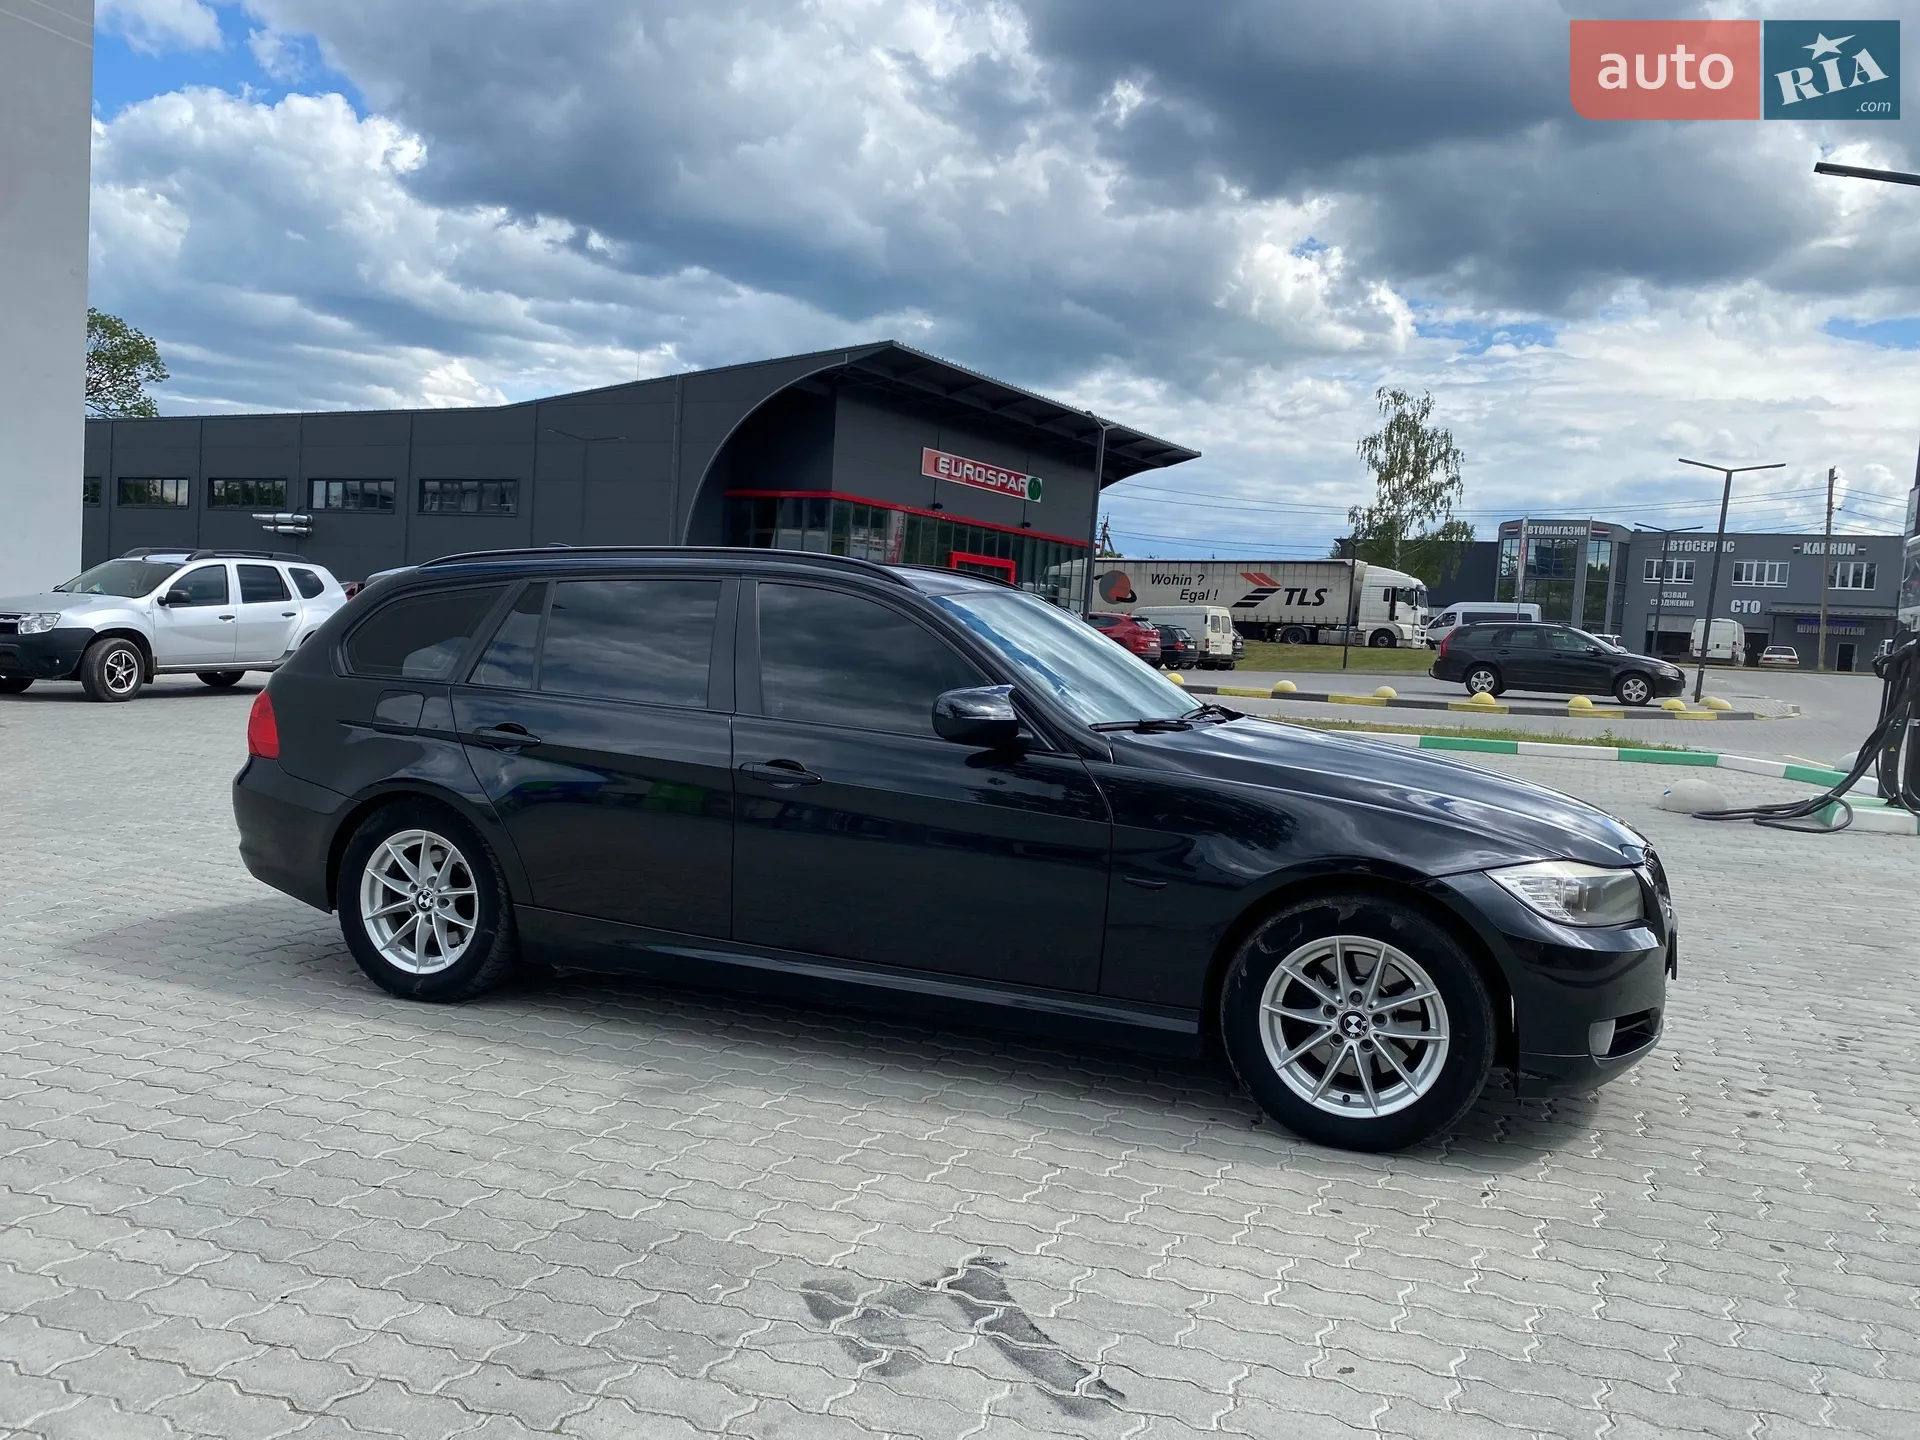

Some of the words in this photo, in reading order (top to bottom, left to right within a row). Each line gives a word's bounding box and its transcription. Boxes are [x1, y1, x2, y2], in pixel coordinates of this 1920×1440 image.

[938, 456, 1027, 493] EUROSPAR
[1526, 525, 1587, 536] ВТОМАГАЗИН
[1151, 574, 1192, 585] Wohin
[1197, 574, 1205, 585] ?
[1179, 589, 1210, 603] Egal
[1213, 589, 1219, 600] !
[1284, 588, 1328, 606] TLS
[1661, 591, 1687, 599] ОЗВАЛ
[1730, 599, 1761, 614] СТО
